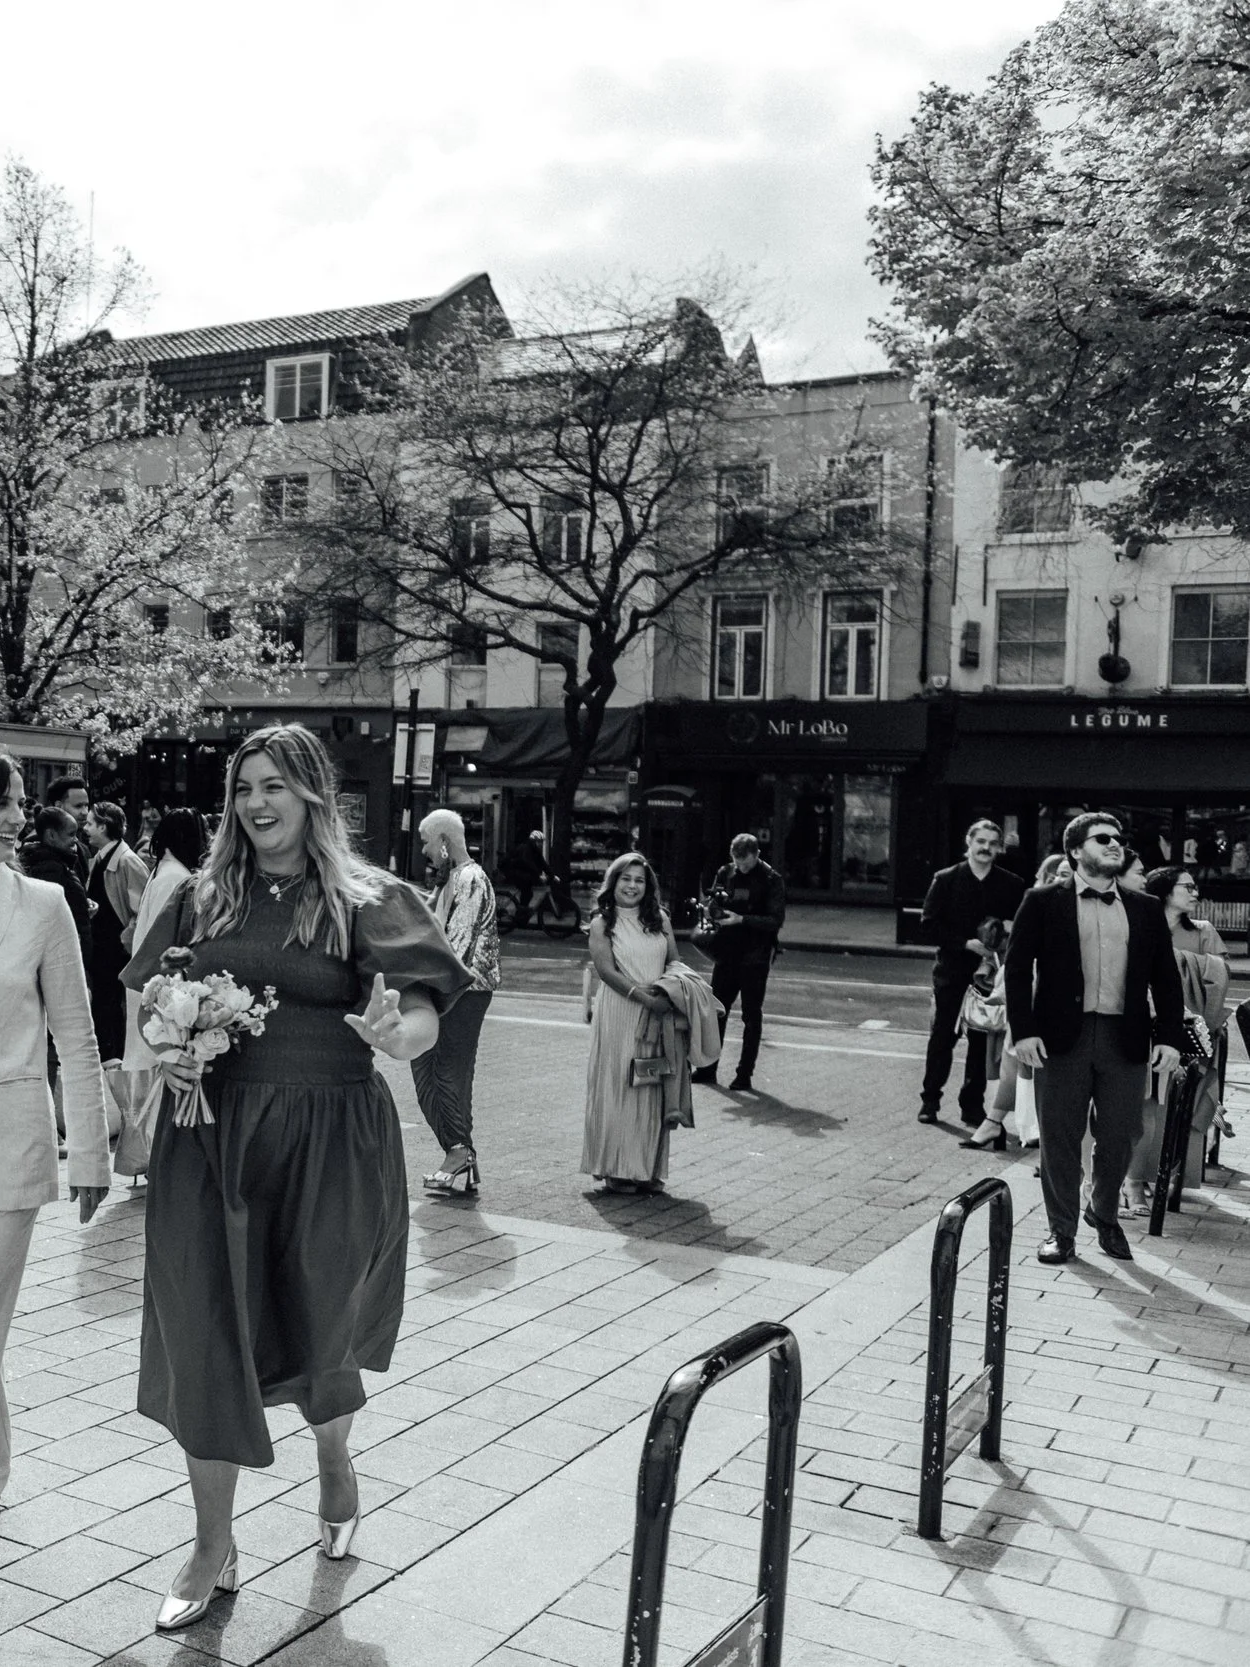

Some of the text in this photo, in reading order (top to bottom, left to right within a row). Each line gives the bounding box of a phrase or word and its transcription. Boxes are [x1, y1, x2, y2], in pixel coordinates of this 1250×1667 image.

[767, 719, 848, 735] Mr LoBo
[1070, 714, 1168, 727] LEGUME
